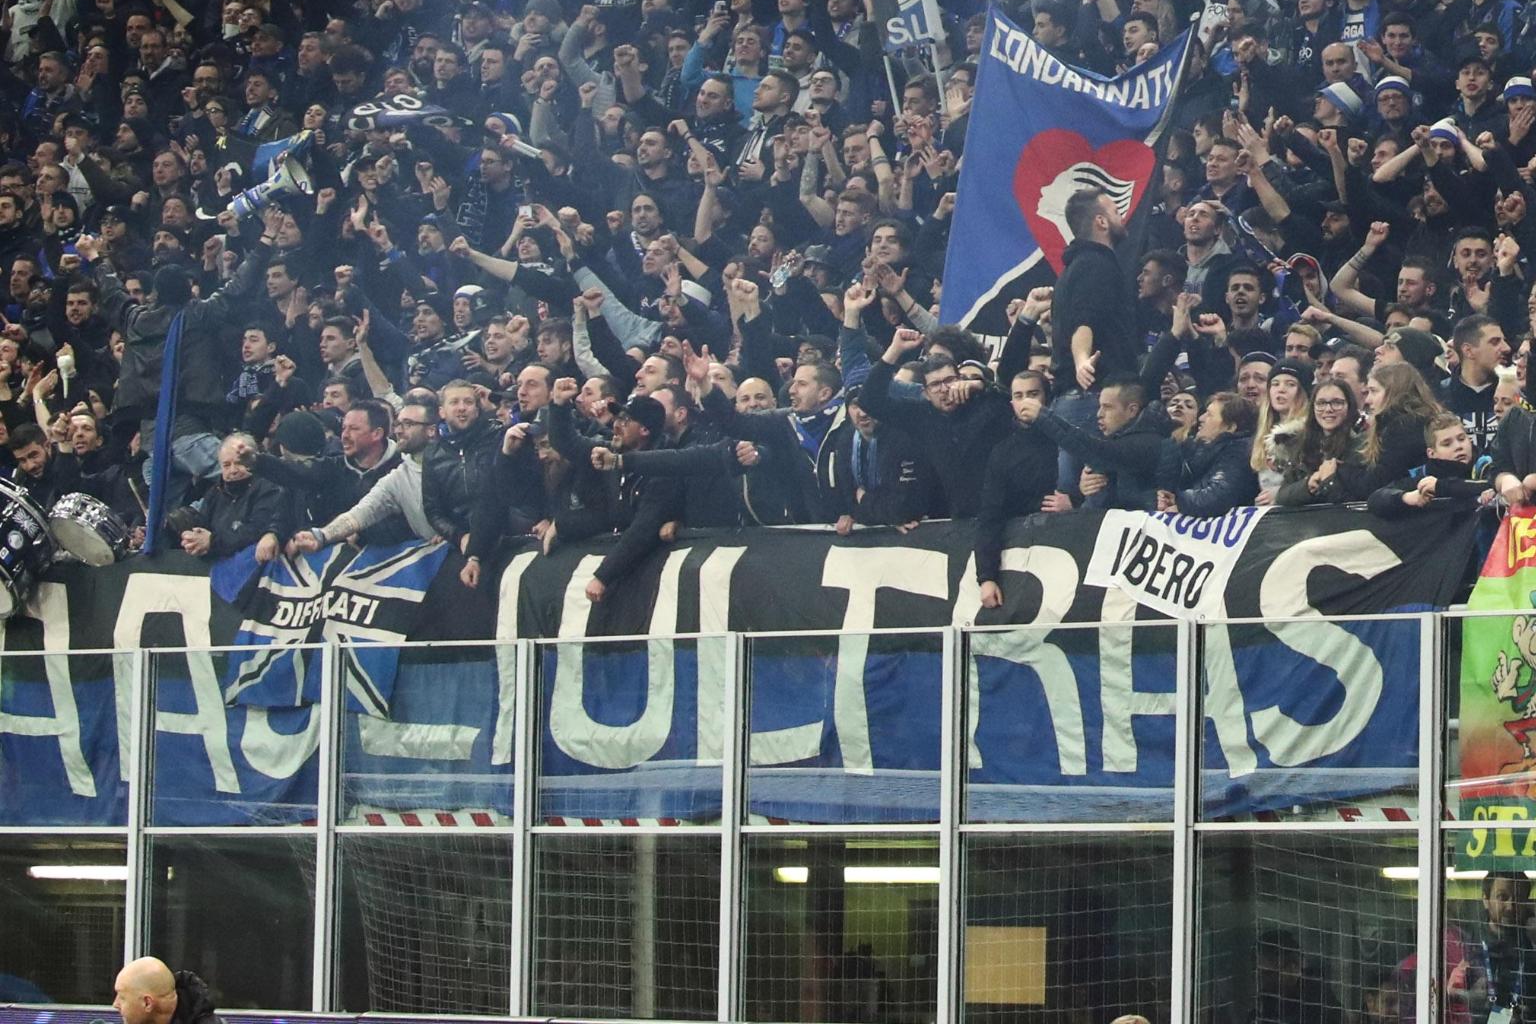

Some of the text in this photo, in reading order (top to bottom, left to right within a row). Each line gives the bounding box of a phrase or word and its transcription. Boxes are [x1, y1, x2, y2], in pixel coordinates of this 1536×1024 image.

[989, 17, 1174, 110] CONDANNATI
[270, 590, 380, 627] DIFFATI
[550, 529, 1403, 778] ULTRAS
